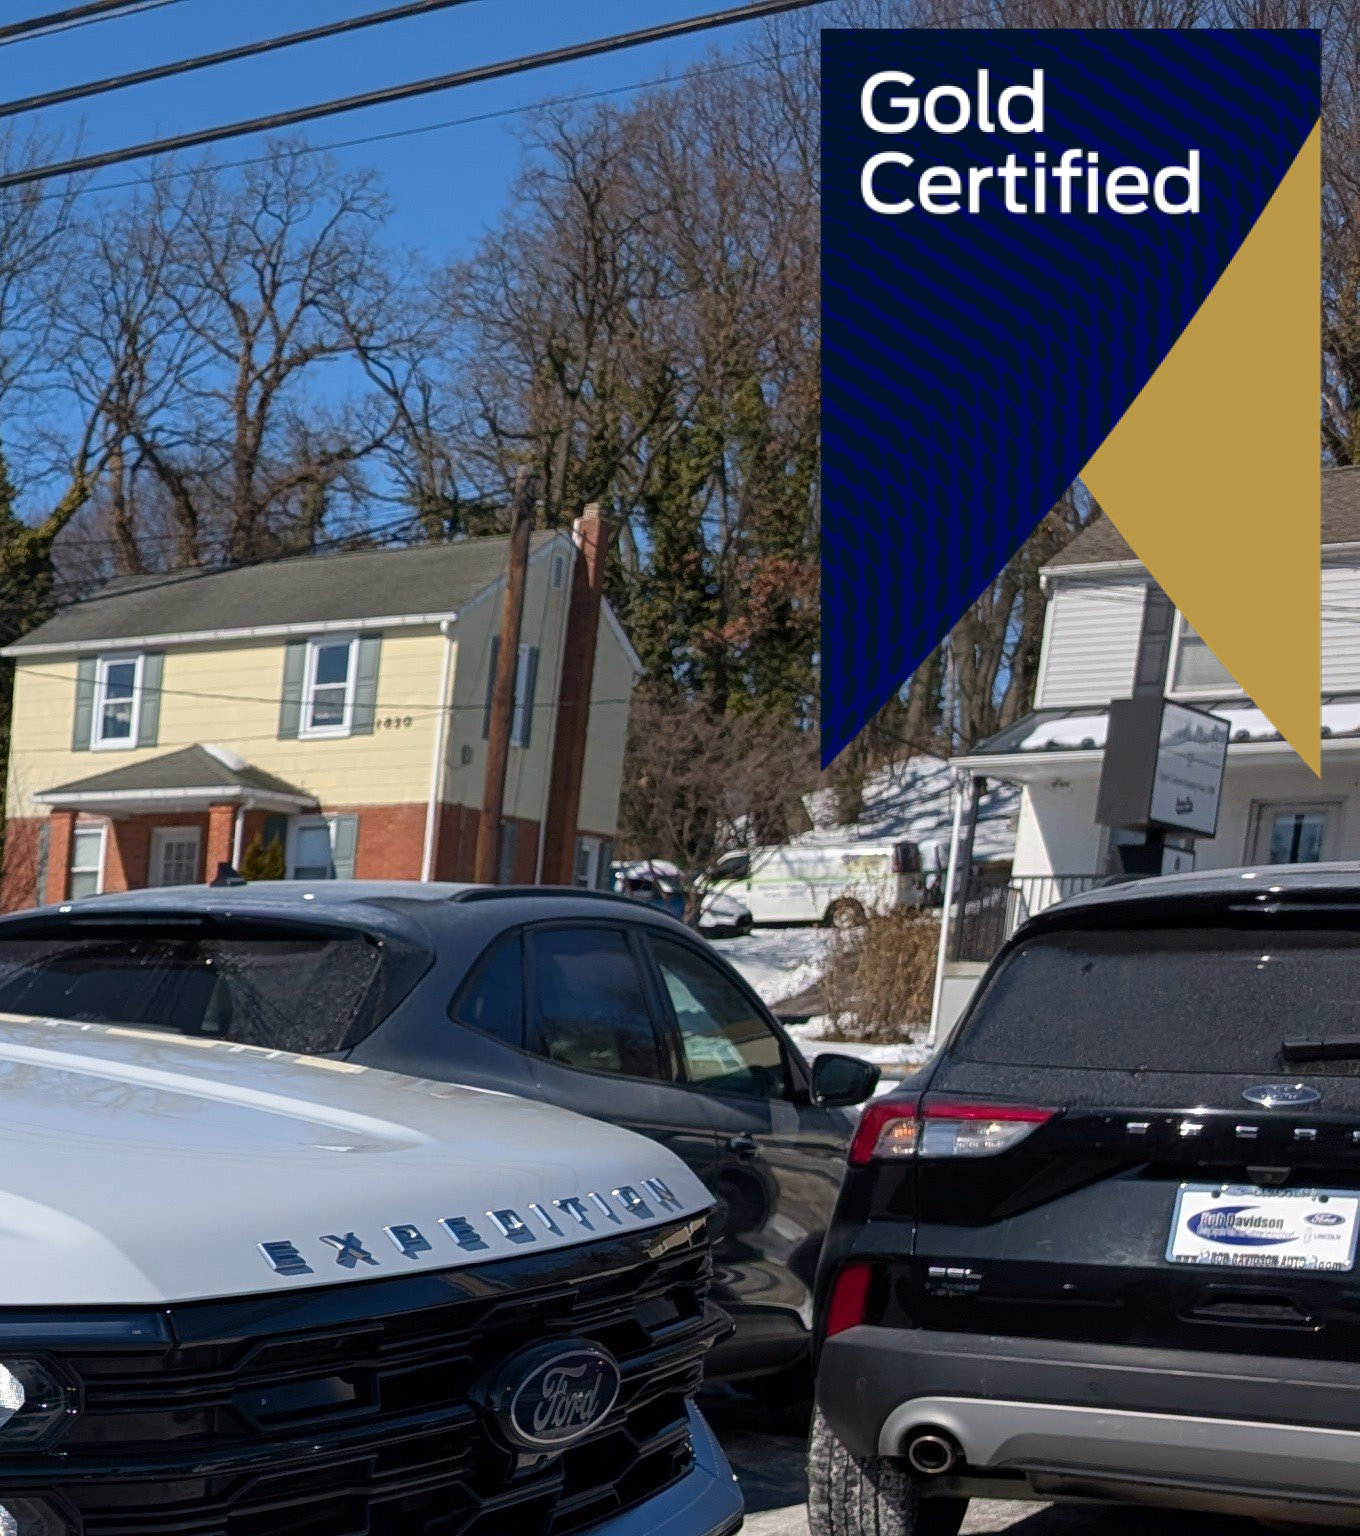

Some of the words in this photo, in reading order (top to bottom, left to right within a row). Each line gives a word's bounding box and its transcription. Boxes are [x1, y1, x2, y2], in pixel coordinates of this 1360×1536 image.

[256, 1176, 683, 1275] EXPEDITION
[1201, 1211, 1226, 1229] Bob
[1227, 1213, 1284, 1231] Davidson
[532, 1363, 604, 1432] Ford
